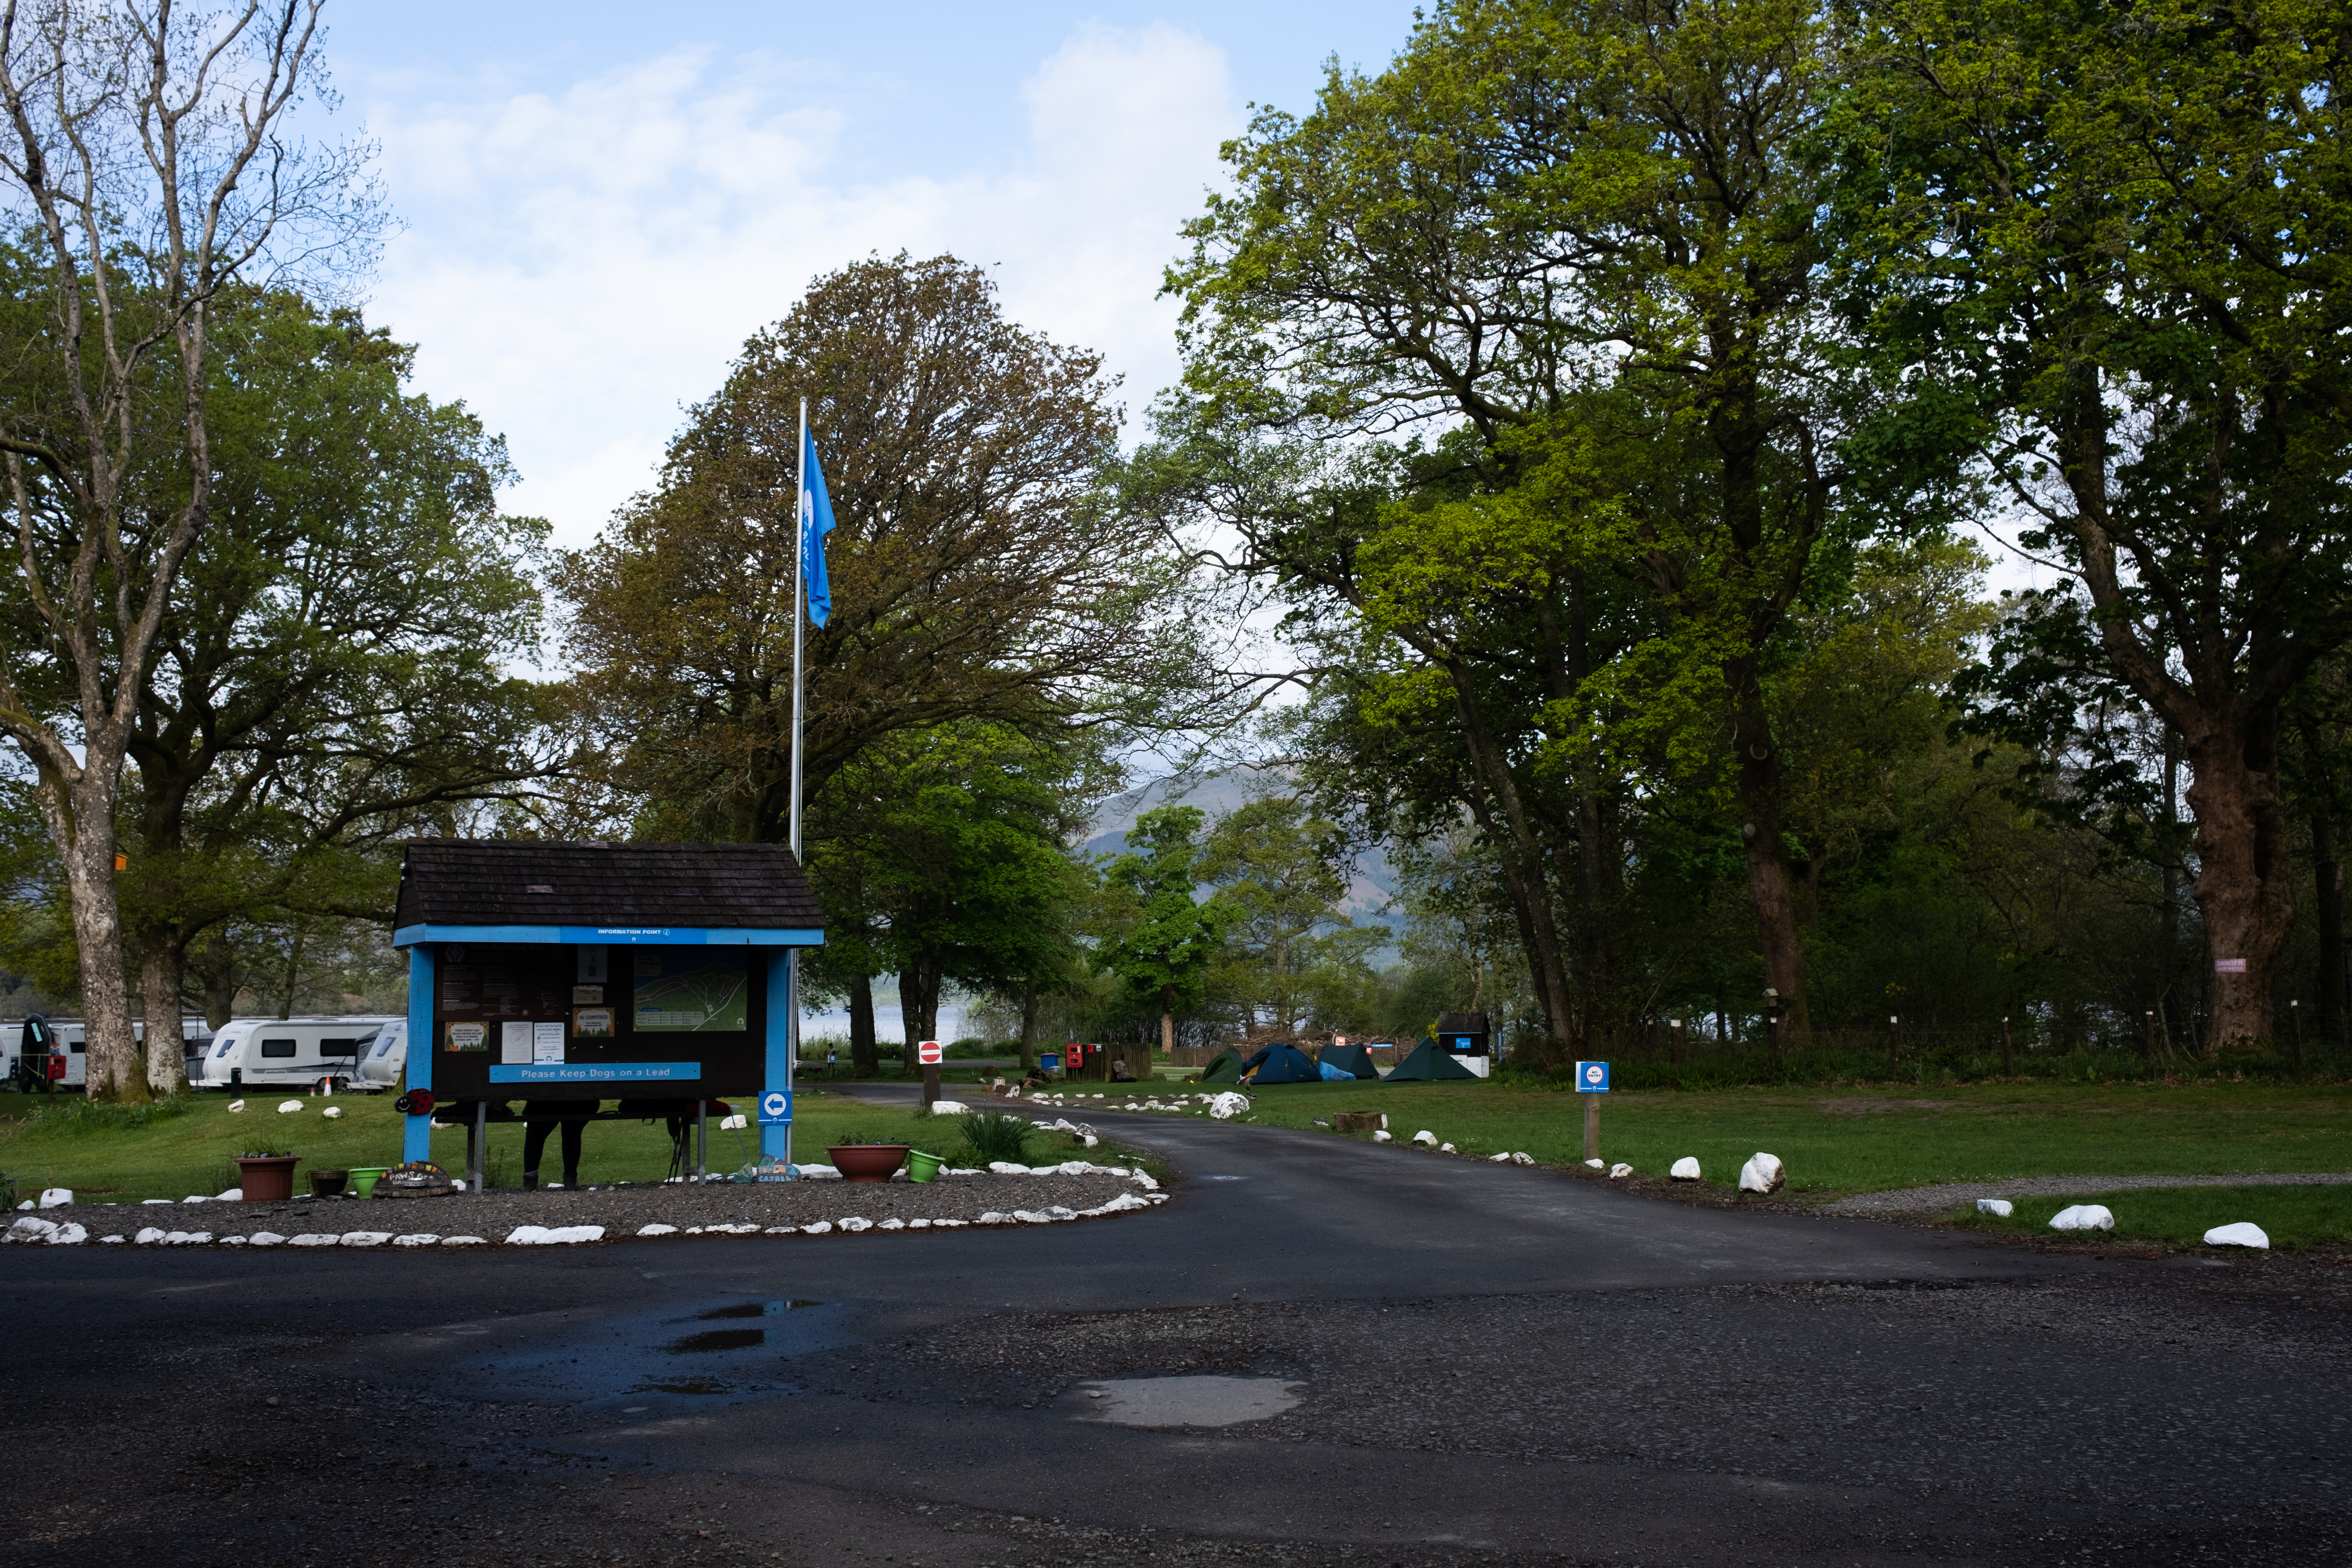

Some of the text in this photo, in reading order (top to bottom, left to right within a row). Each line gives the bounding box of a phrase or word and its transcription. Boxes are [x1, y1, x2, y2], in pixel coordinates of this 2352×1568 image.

[560, 1070, 586, 1078] Keep
[590, 1069, 615, 1078] Dogs
[389, 1171, 415, 1180] PAWS
